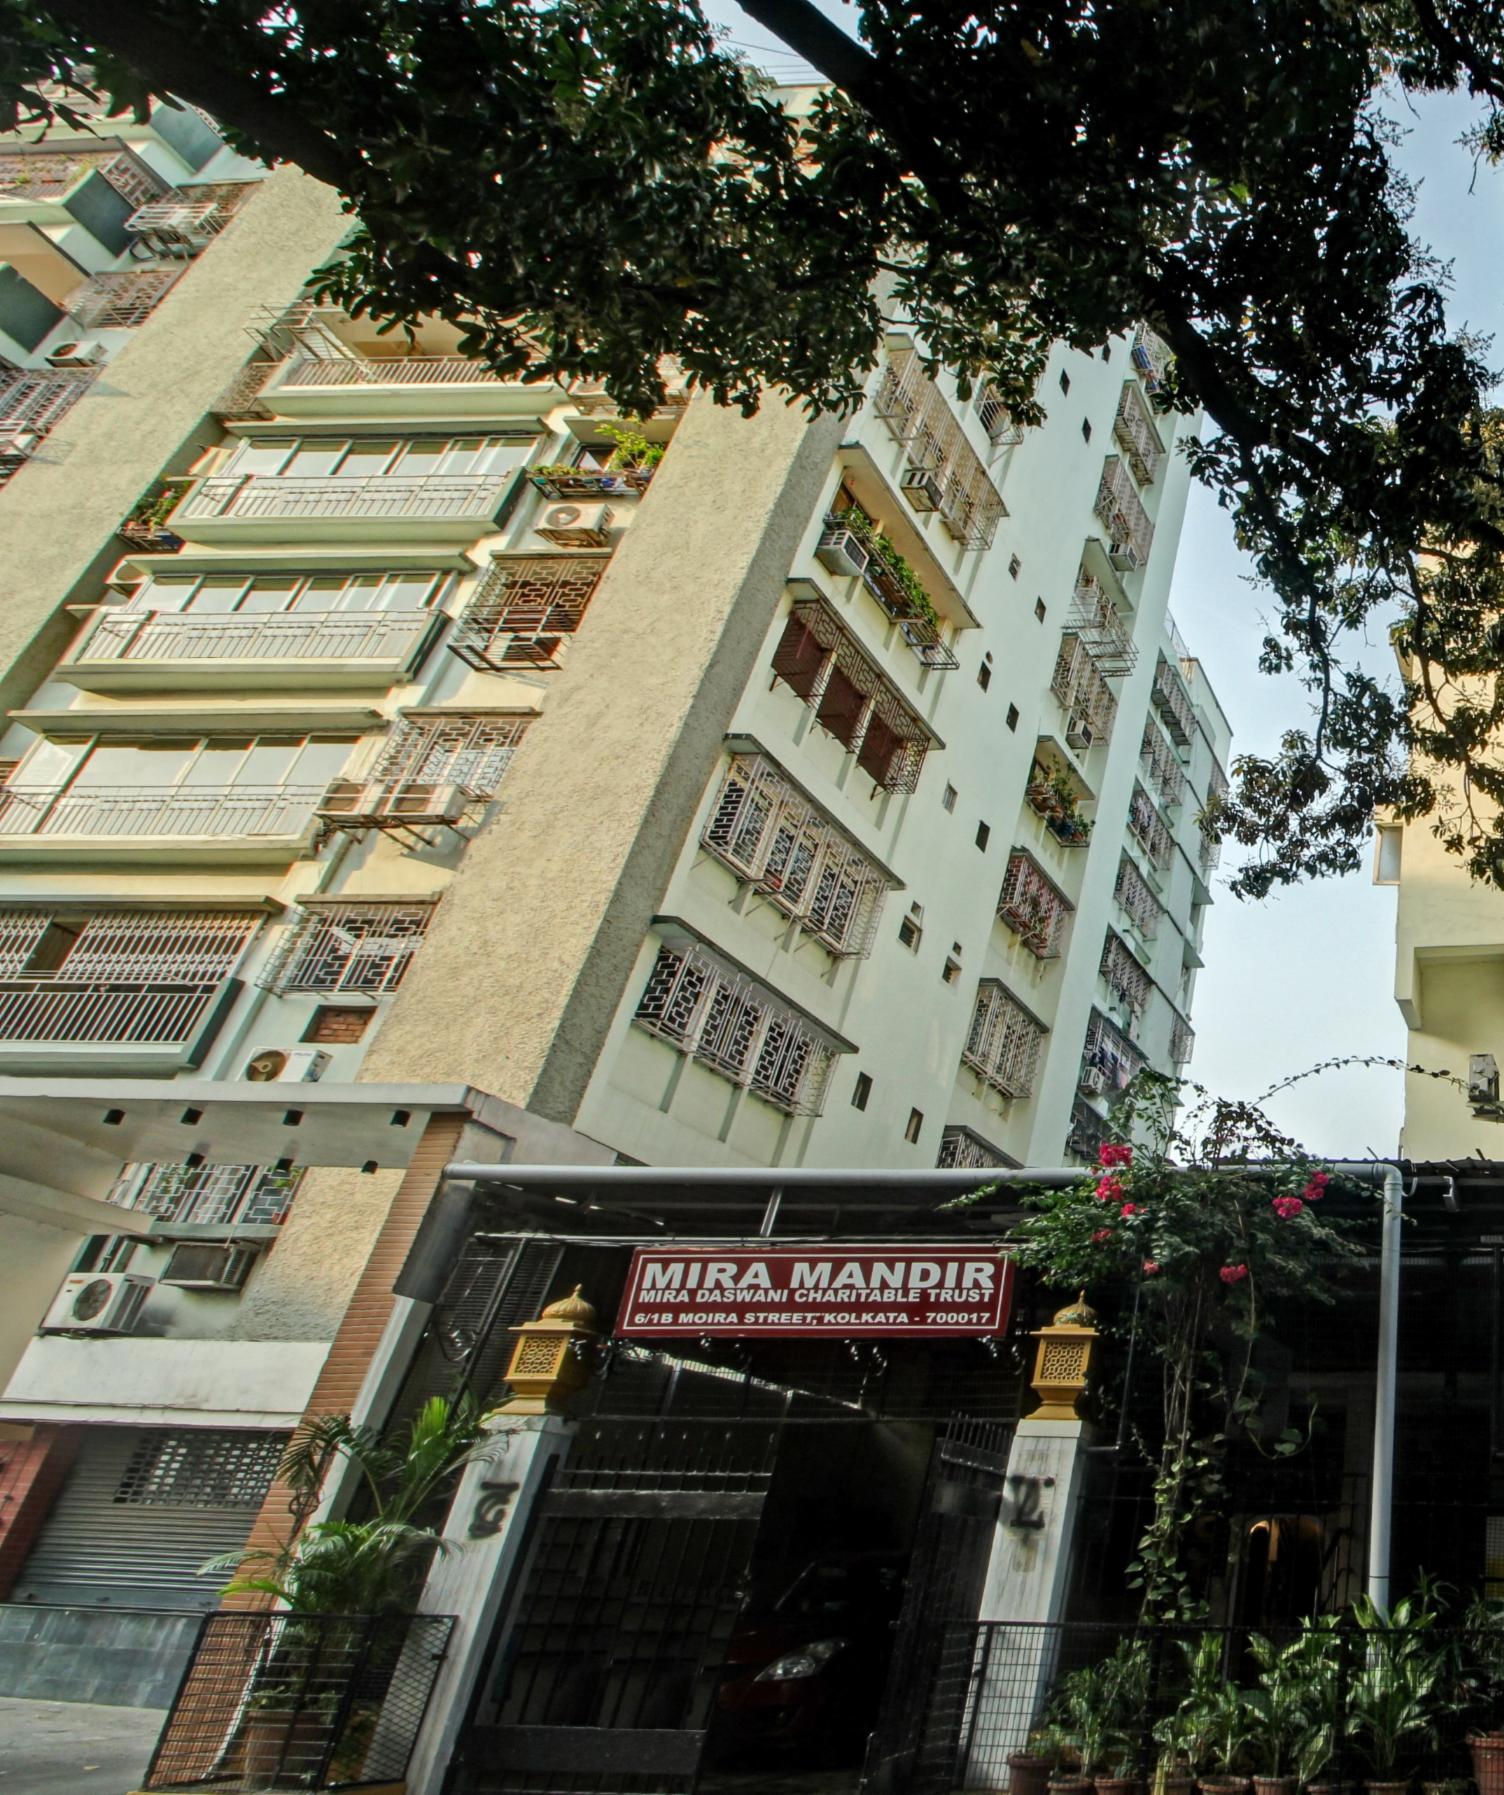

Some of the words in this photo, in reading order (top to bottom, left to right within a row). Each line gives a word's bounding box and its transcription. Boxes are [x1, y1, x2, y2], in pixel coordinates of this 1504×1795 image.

[641, 1262, 772, 1289] MIRA
[789, 1262, 995, 1289] MANDIR
[638, 1289, 690, 1303] MIRA
[695, 1289, 789, 1303] DASWANI
[794, 1288, 922, 1303] CHARITABLE
[927, 1288, 994, 1303] TRUST
[634, 1312, 674, 1324] 6/1B
[678, 1312, 739, 1324] MOIRA
[743, 1312, 818, 1326] STREET,
[823, 1312, 909, 1324] KOLKATA
[925, 1312, 991, 1324] 700017
